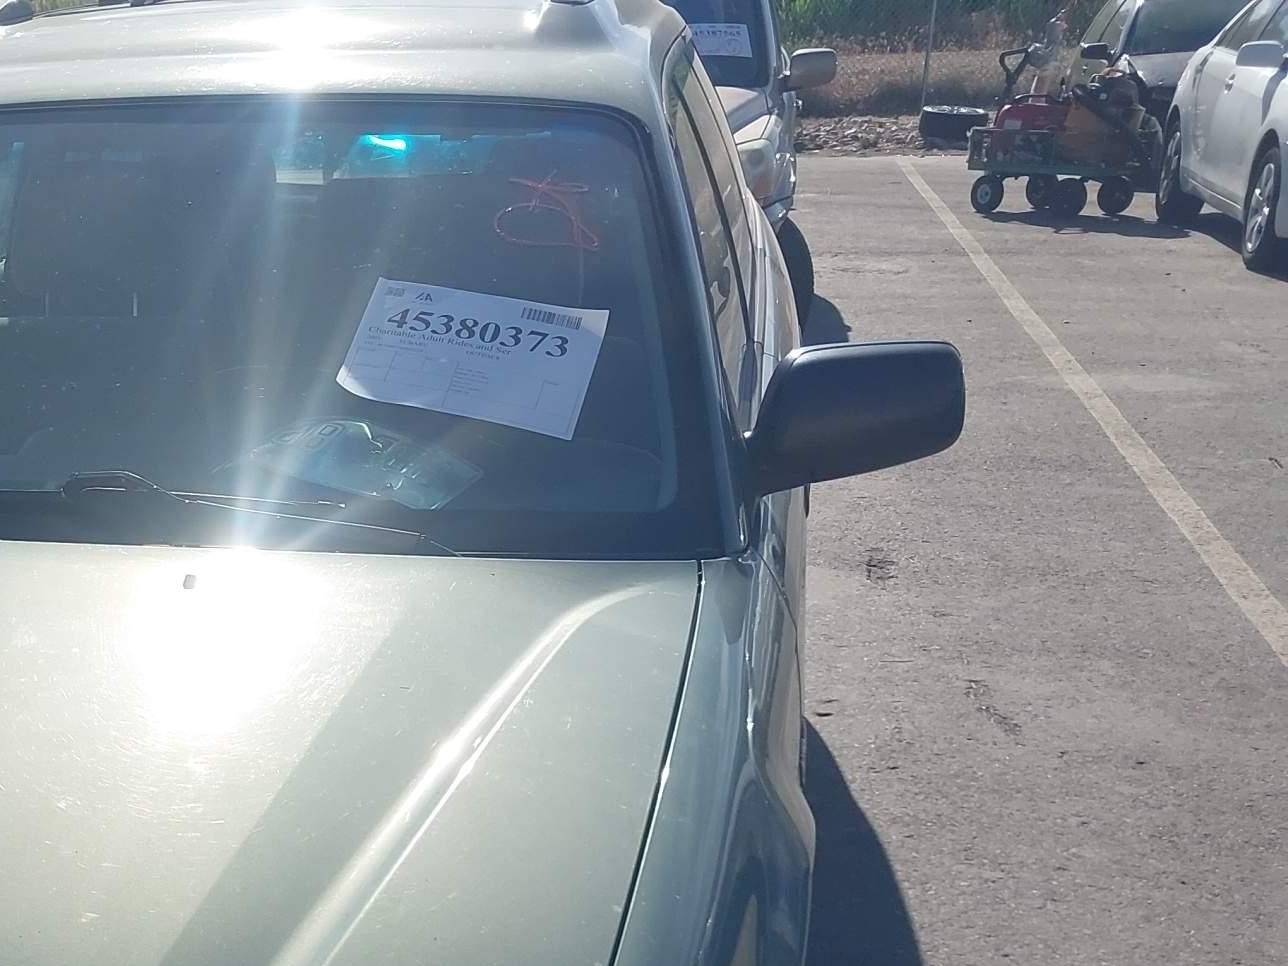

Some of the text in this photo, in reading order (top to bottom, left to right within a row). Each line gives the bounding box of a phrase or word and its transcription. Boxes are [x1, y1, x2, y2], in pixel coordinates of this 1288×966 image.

[368, 326, 416, 339] Charitable
[475, 343, 494, 353] and
[386, 308, 569, 358] 45380373
